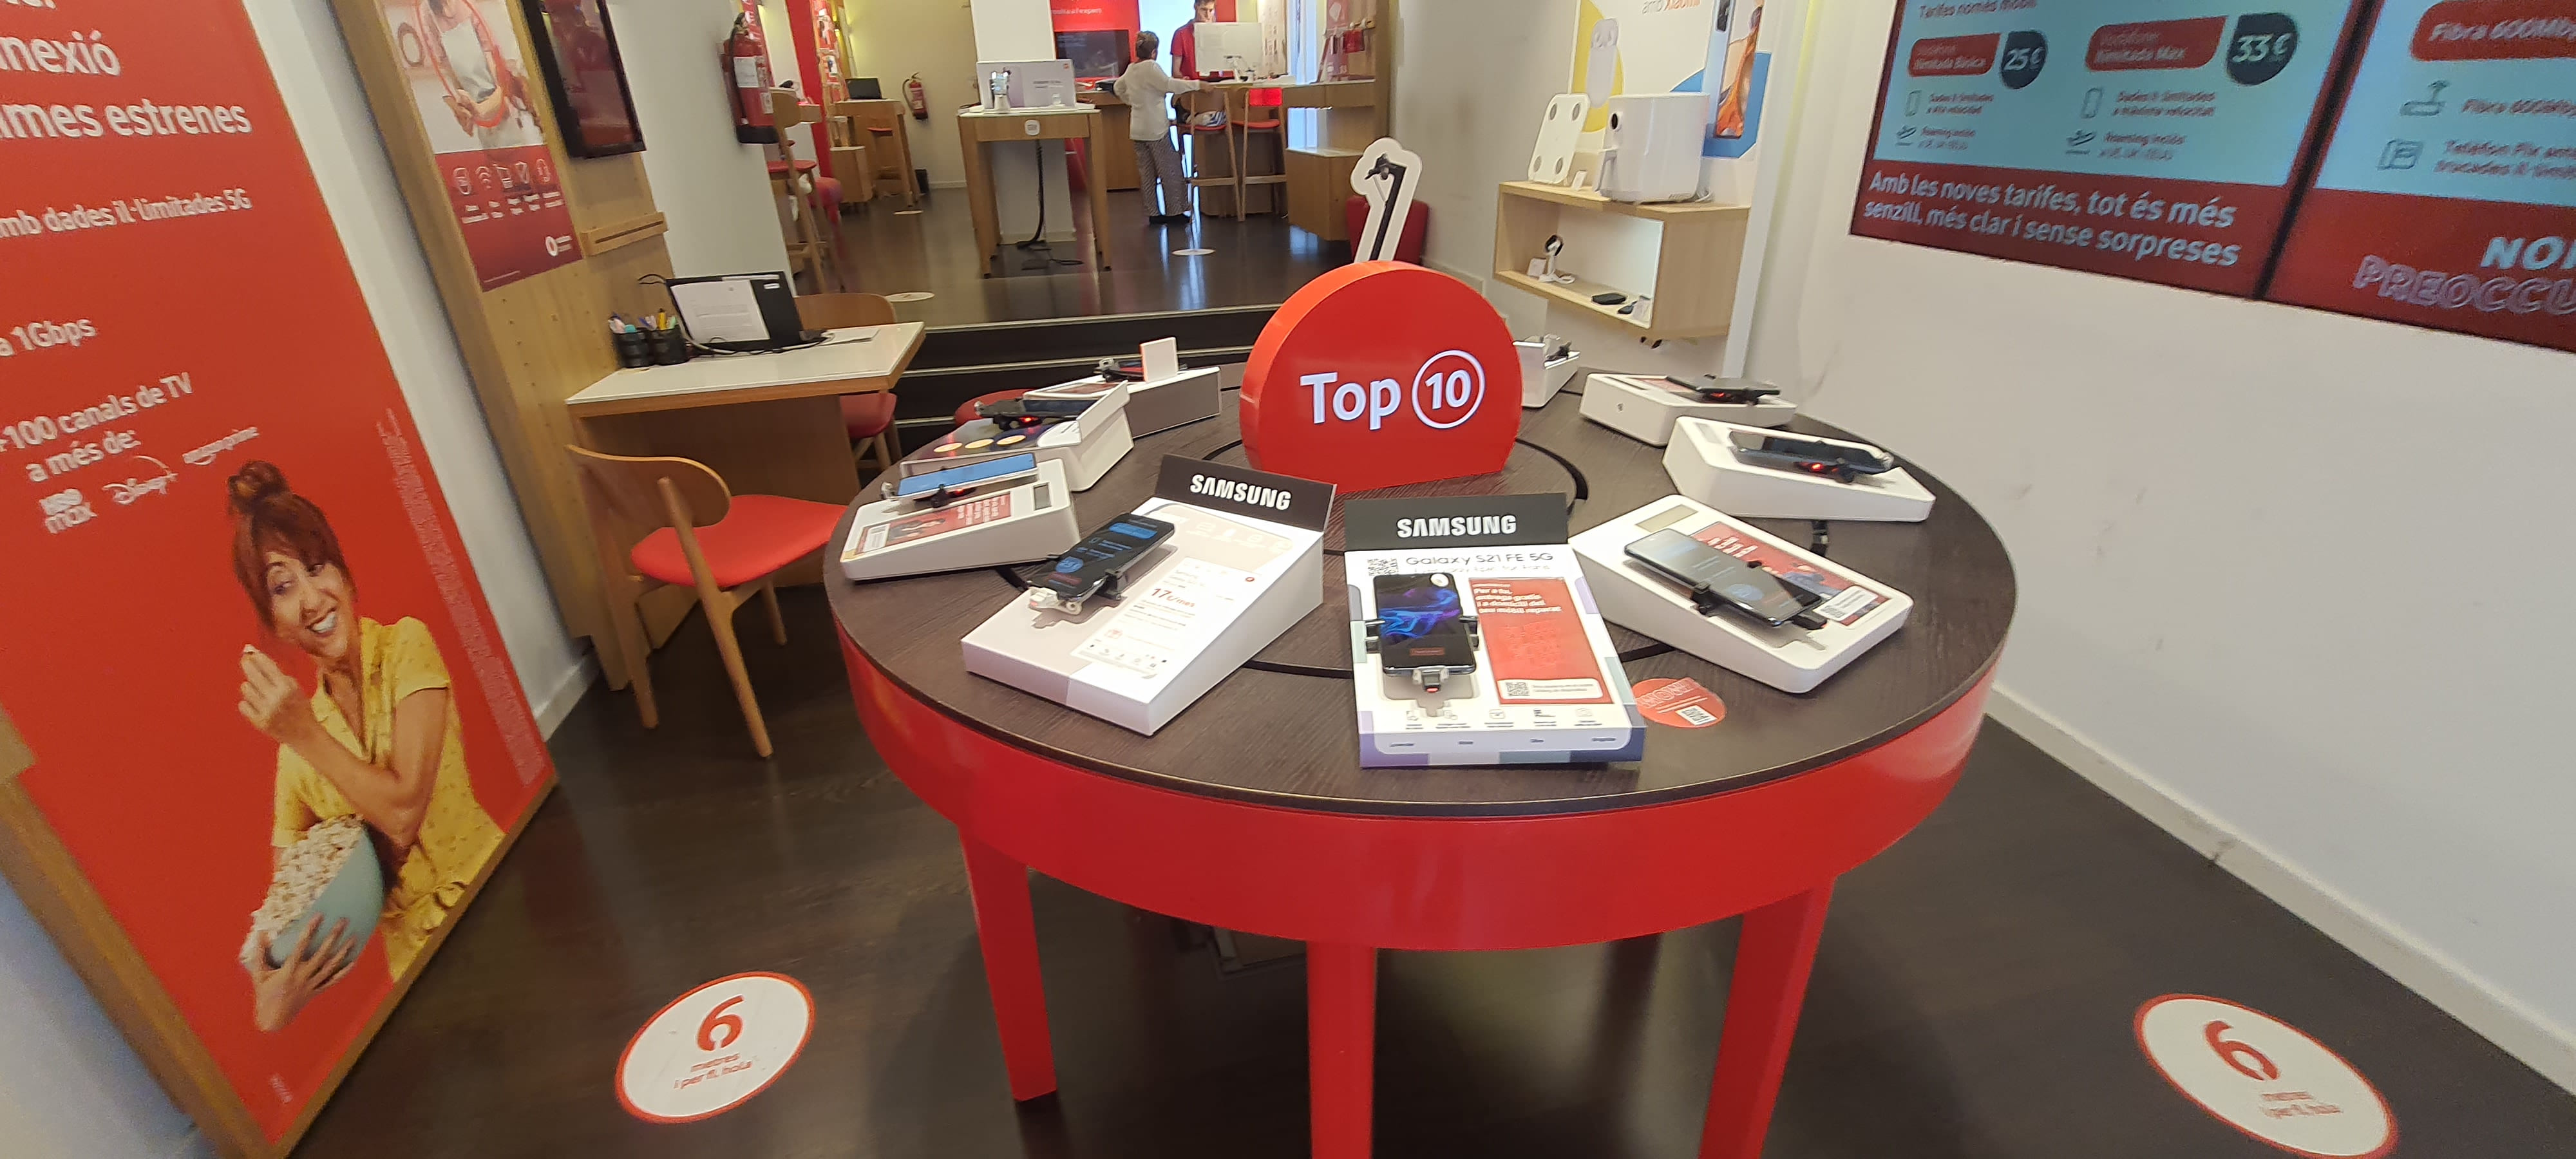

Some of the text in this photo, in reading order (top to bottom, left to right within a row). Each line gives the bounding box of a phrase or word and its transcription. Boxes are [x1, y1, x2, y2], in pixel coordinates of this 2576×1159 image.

[2003, 46, 2045, 71] 25€
[2232, 32, 2291, 62] 33€
[104, 97, 252, 137] estrenes
[43, 203, 117, 232] dades
[223, 187, 252, 211] 5G
[1868, 170, 2238, 229] Amb les noves tarifes, tot és més
[1925, 205, 1968, 231] més
[1969, 210, 2009, 236] clar
[2011, 211, 2022, 237] i
[2023, 219, 2094, 247] sense
[2095, 227, 2242, 267] sorpreses
[2479, 236, 2576, 270] NO
[10, 318, 97, 351] 1Gbps
[57, 394, 138, 433] canals
[135, 384, 167, 409] de
[159, 371, 193, 398] TV
[1300, 369, 1472, 431] Top 10
[26, 462, 49, 482] a
[44, 440, 105, 475] més
[1189, 474, 1292, 511] SAMSUNG
[1396, 514, 1517, 538] SAMSUNG
[1405, 552, 1554, 565] Galaxy S21 FE 5G
[696, 994, 745, 1052] 6
[2204, 1019, 2281, 1081] 6
